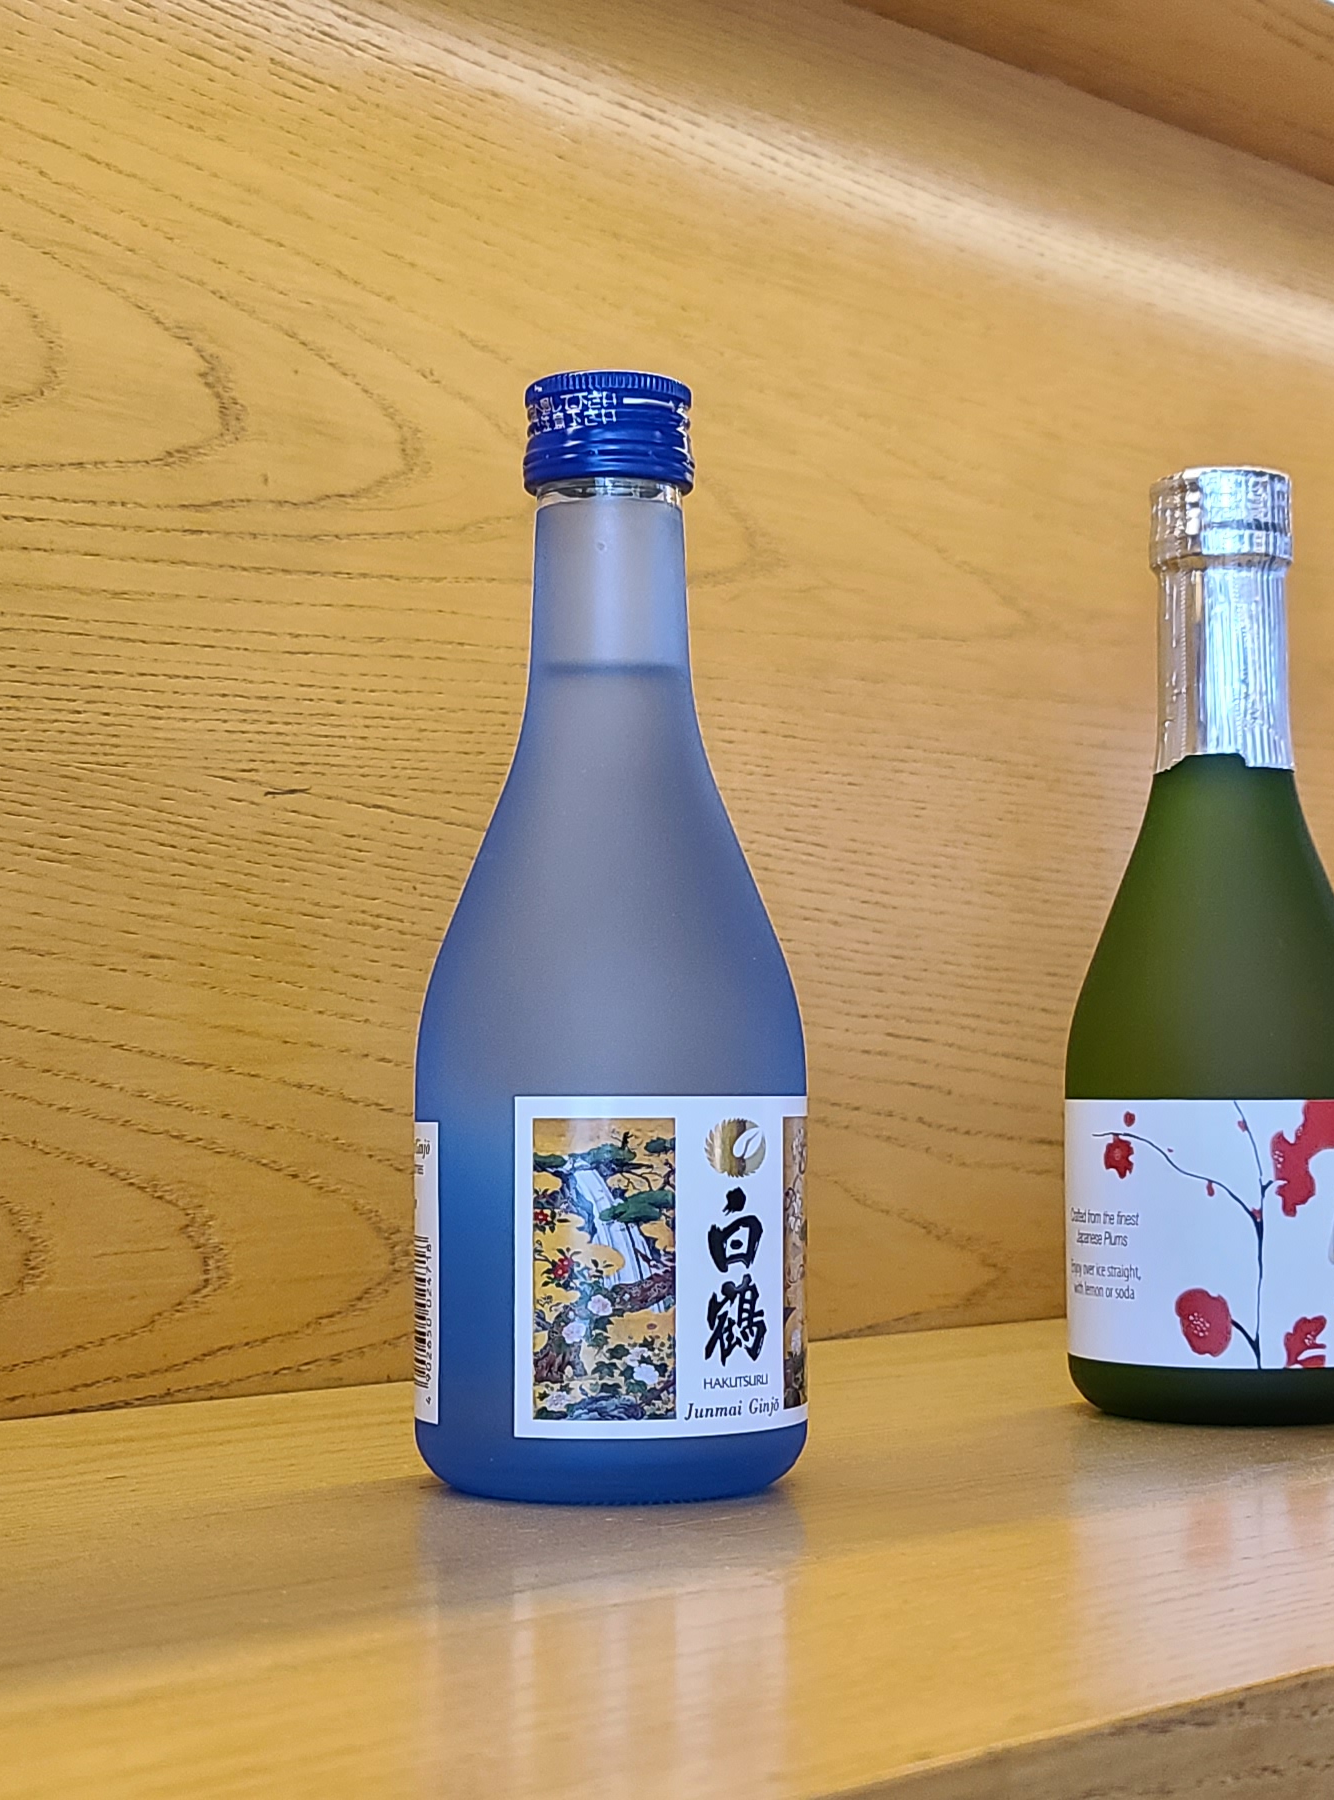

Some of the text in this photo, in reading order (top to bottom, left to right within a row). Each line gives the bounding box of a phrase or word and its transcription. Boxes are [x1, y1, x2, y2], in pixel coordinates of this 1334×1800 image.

[1087, 1208, 1102, 1225] from
[1102, 1210, 1115, 1225] the
[1116, 1210, 1140, 1227] finest
[1103, 1230, 1129, 1248] Plums
[704, 1186, 769, 1367] 白鶴
[1095, 1262, 1106, 1277] ice
[1106, 1263, 1142, 1282] straight,
[1084, 1281, 1104, 1298] lemon
[1105, 1285, 1114, 1299] or
[1114, 1284, 1136, 1300] soda
[703, 1373, 769, 1390] HAKUTSURU
[684, 1400, 743, 1421] Junmai
